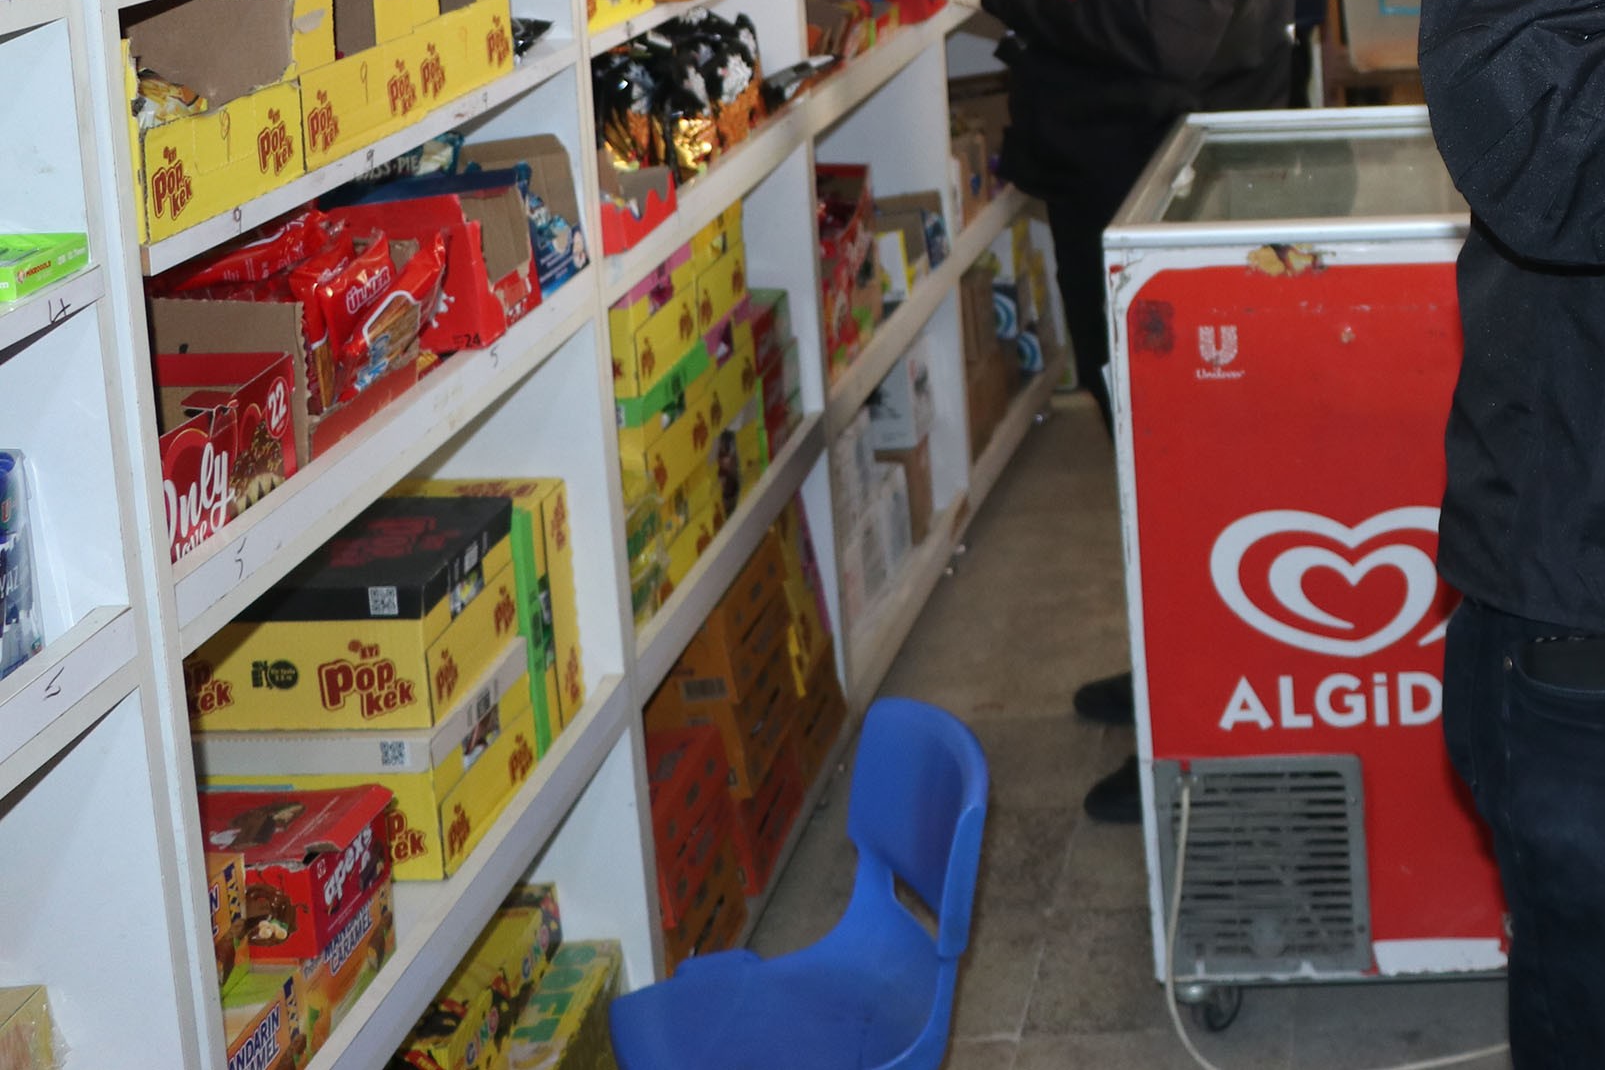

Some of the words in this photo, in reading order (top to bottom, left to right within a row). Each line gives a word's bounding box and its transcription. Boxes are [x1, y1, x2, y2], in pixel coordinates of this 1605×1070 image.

[463, 333, 481, 348] 24
[1196, 368, 1243, 380] Unilever
[267, 381, 287, 427] 22
[1219, 672, 1443, 731] ALGiD
[228, 1000, 281, 1070] ANDARIN
